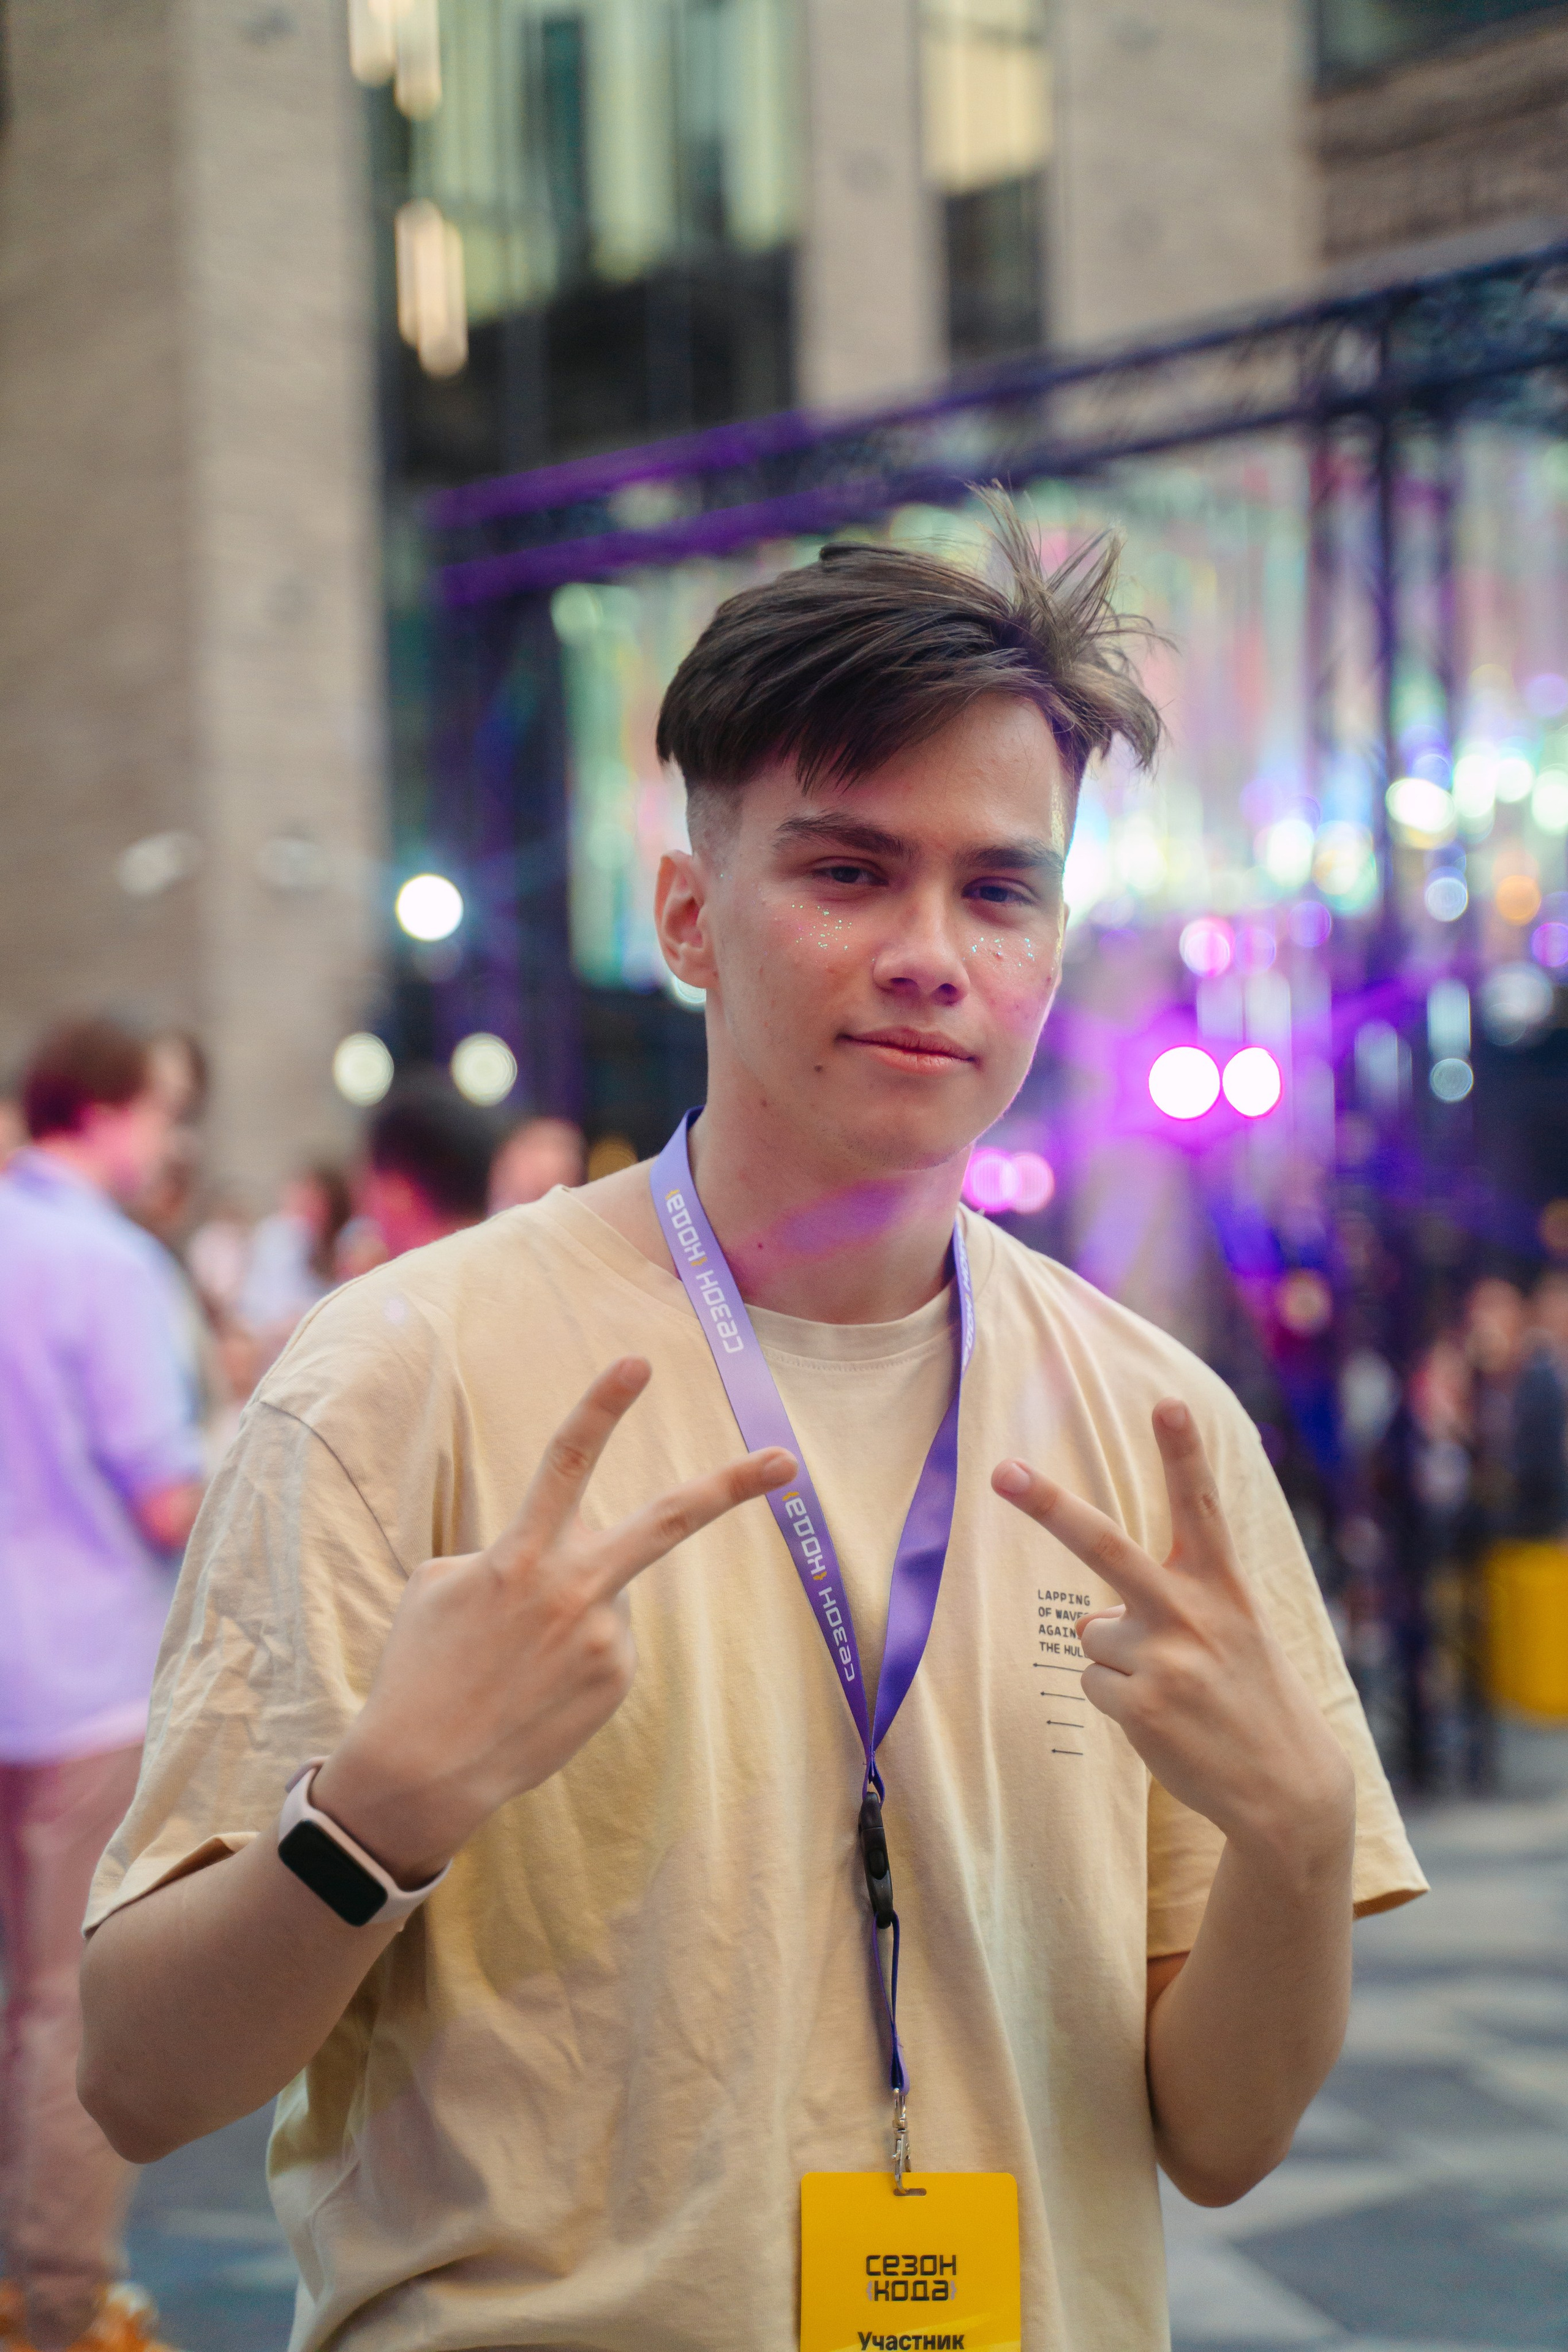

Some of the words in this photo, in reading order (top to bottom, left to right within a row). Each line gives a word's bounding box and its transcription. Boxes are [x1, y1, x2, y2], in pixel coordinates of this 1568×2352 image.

[1038, 1589, 1090, 1606] LAPPING
[1038, 1607, 1052, 1617] OF
[1055, 1609, 1088, 1621] WAVE
[1039, 1624, 1077, 1638] AGAIN
[1039, 1642, 1060, 1654] THE
[1064, 1645, 1088, 1658] HUL
[858, 2331, 965, 2351] Участник
